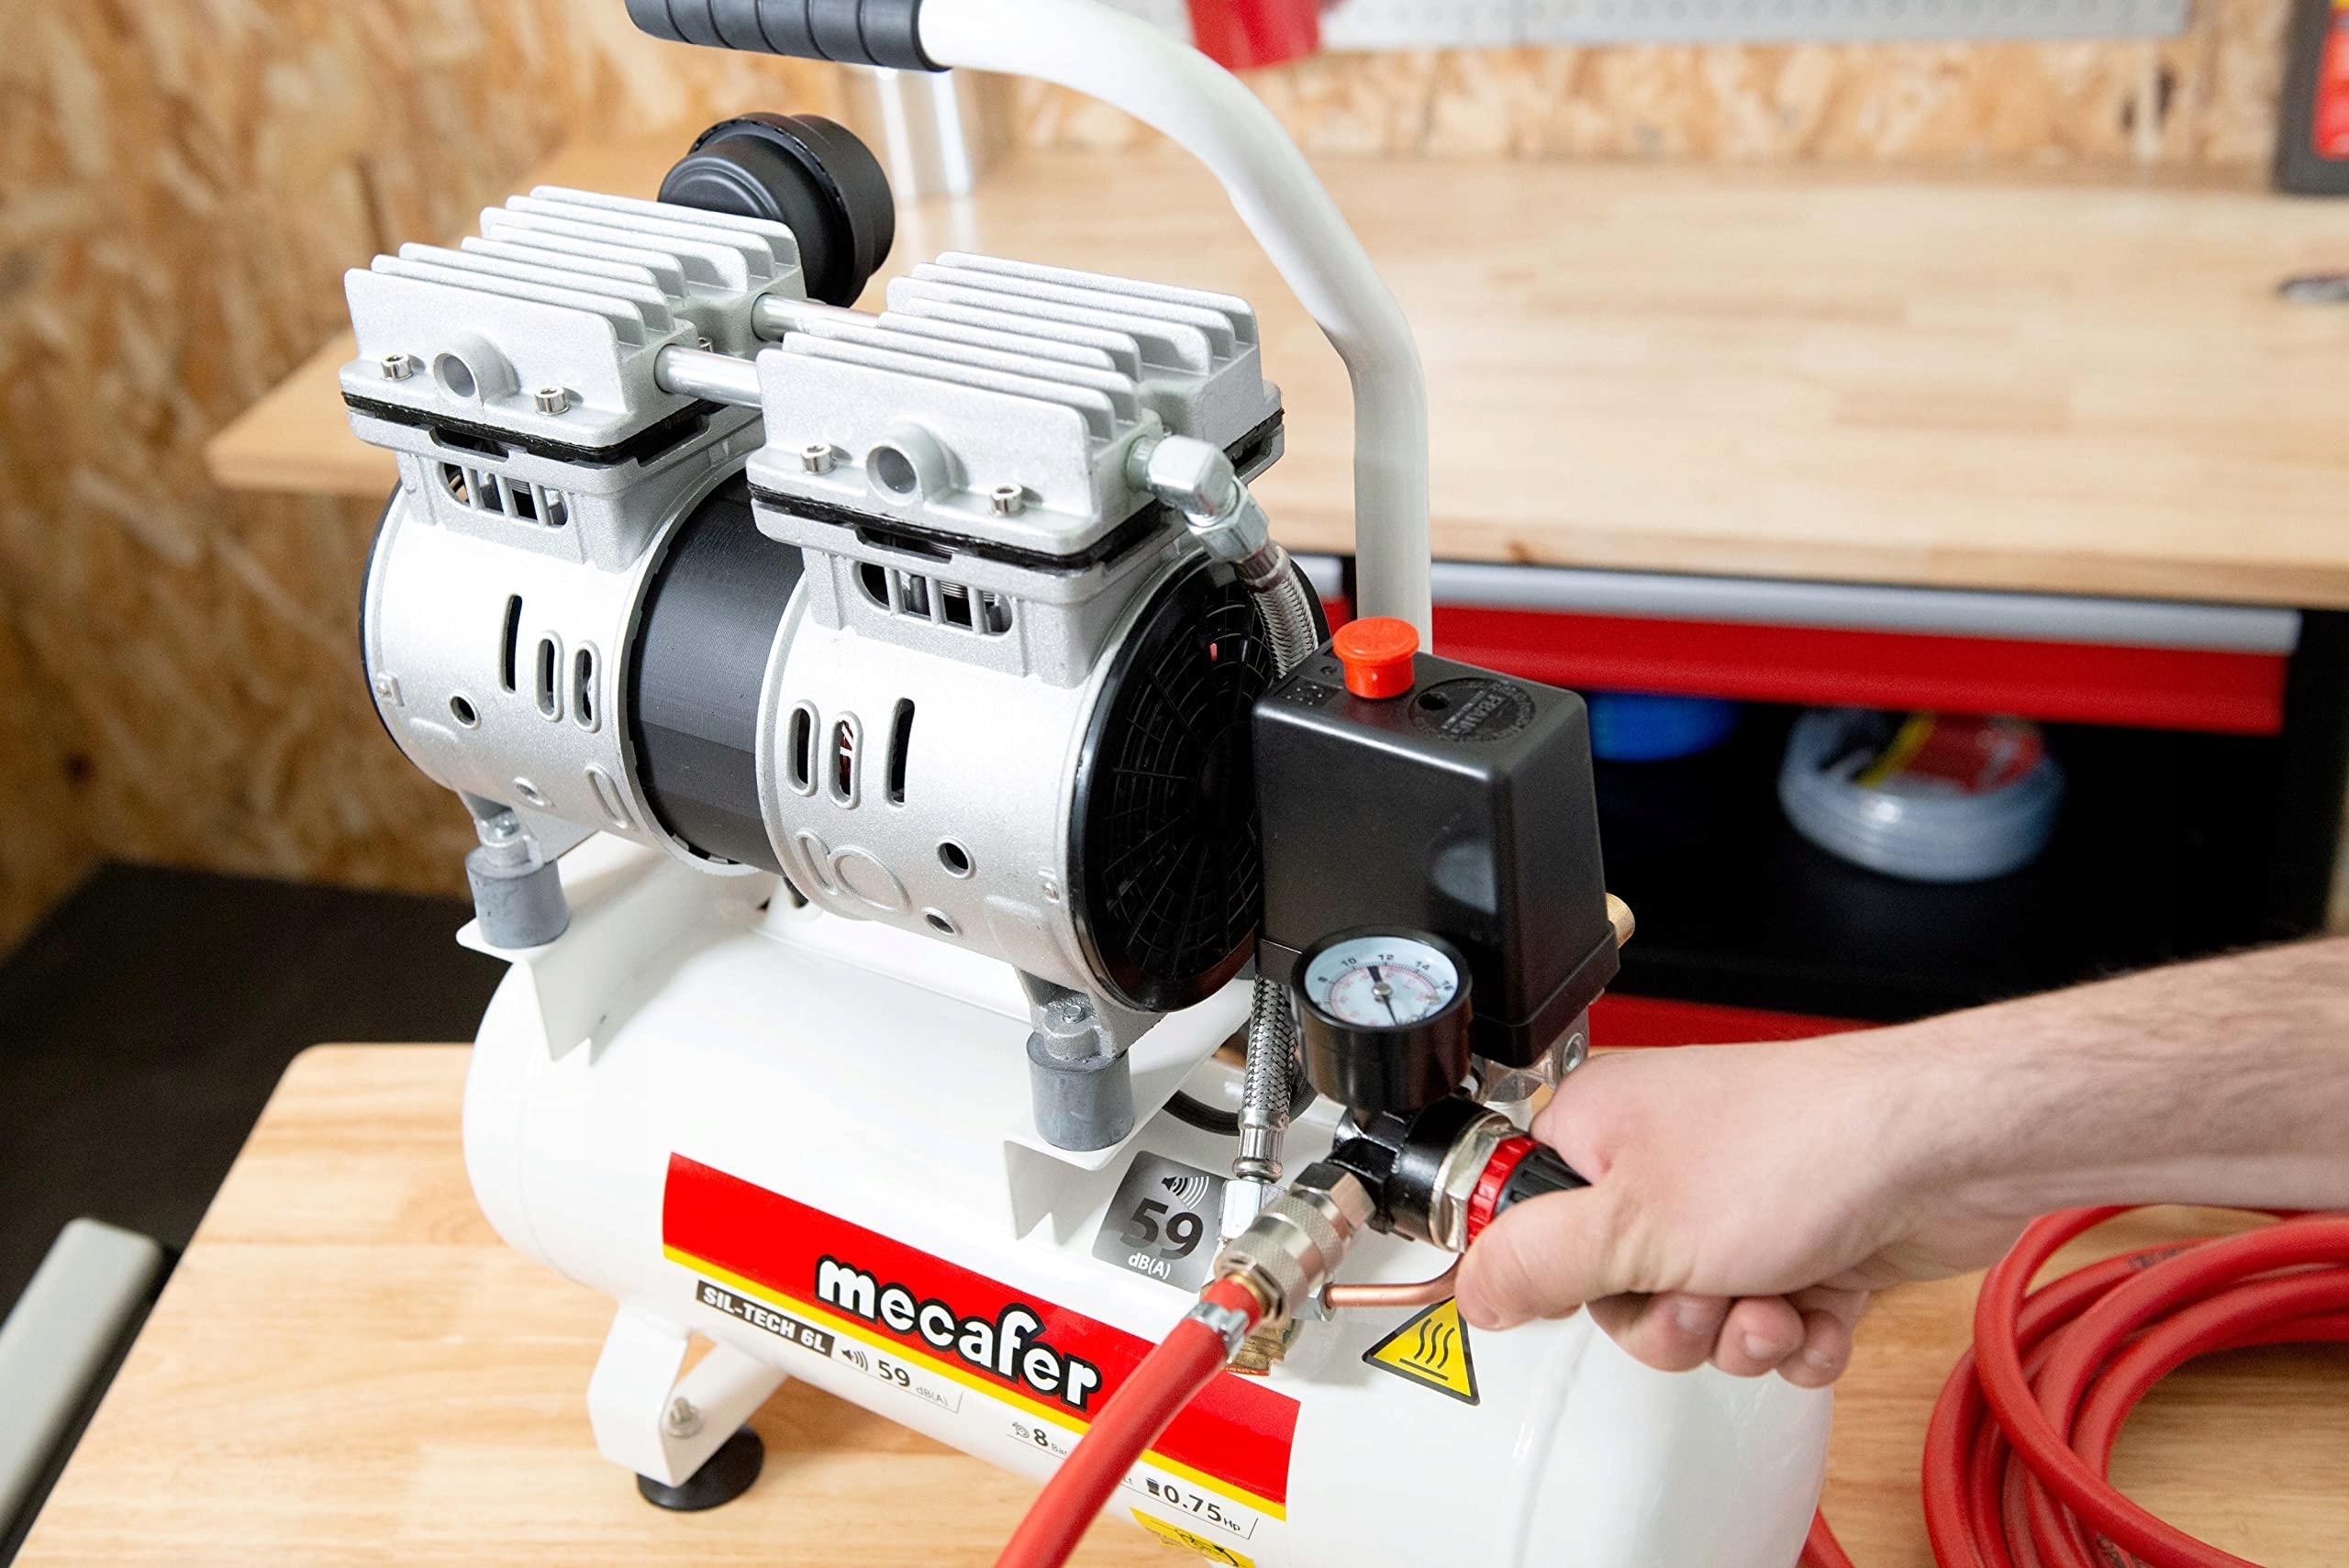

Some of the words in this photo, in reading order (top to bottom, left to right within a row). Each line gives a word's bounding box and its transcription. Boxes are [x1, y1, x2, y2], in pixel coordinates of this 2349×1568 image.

[1341, 957, 1358, 966] 10
[1119, 1196, 1204, 1261] 59
[1128, 1251, 1172, 1280] dB(A)
[702, 1285, 796, 1340] SIL-TECH
[800, 1328, 828, 1353] 6L
[816, 1255, 1102, 1410] mecafer
[877, 1359, 911, 1388] 59
[915, 1385, 950, 1407] dB(A)
[1033, 1428, 1049, 1447] 8
[1163, 1484, 1222, 1523] 0.75
[1224, 1518, 1241, 1532] Hp
